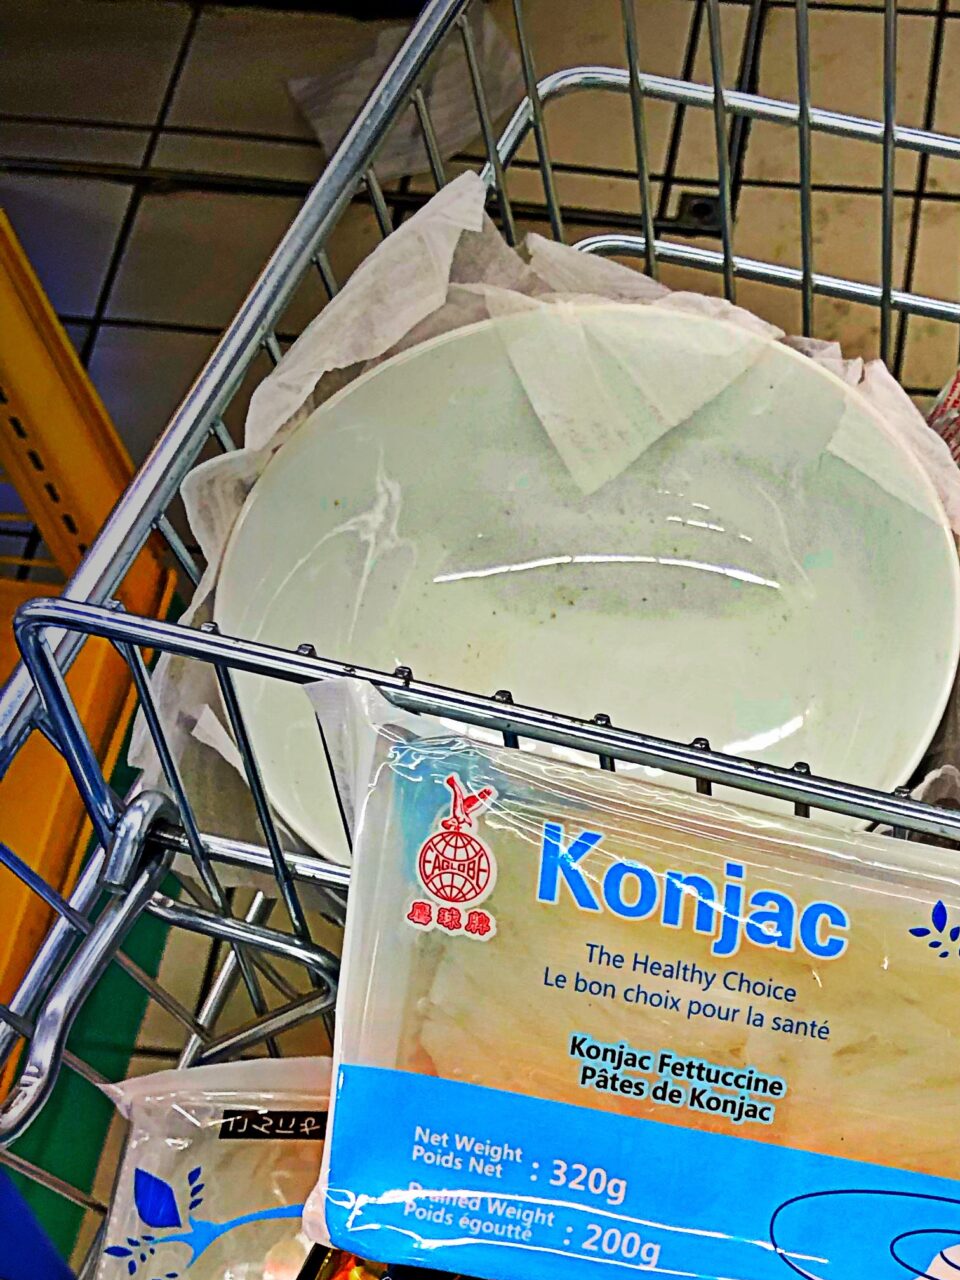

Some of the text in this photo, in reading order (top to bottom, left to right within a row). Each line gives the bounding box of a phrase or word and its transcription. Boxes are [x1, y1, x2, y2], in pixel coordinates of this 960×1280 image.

[422, 844, 489, 889] EAGLOBE
[537, 822, 848, 957] Konjac
[586, 943, 797, 1003] The Healthy Choice
[543, 967, 831, 1040] Le bon choix pour la santé
[569, 1035, 783, 1096] Konjac Fettuccine
[580, 1066, 772, 1122] Pâtes de Konjac
[411, 1145, 503, 1179] Poids Net
[414, 1126, 523, 1163] Net Weight
[549, 1158, 628, 1205] 320g
[403, 1200, 533, 1241] Poids égoutté
[486, 1198, 555, 1227] Weight
[581, 1223, 661, 1268] 200g
